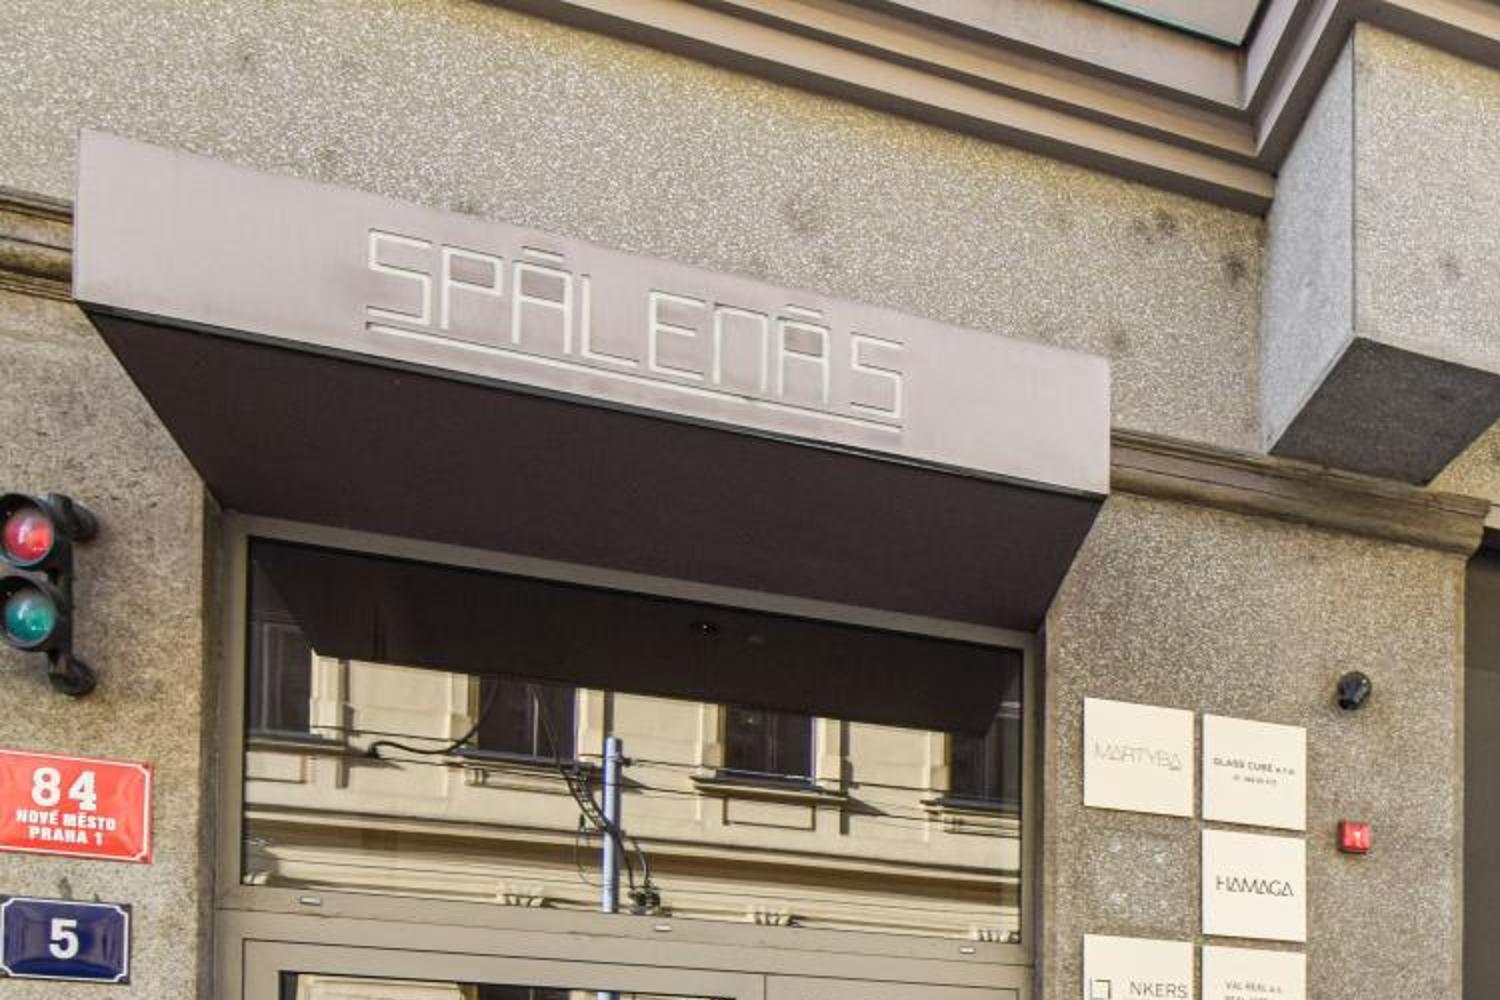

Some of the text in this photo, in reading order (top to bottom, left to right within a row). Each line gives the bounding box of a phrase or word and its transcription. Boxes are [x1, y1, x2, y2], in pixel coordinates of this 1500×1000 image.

[31, 767, 97, 812] 84
[16, 808, 59, 825] NOVÉ
[28, 825, 103, 846] PRAHA 1
[1215, 874, 1295, 897] HAMAGA
[49, 917, 79, 960] 5
